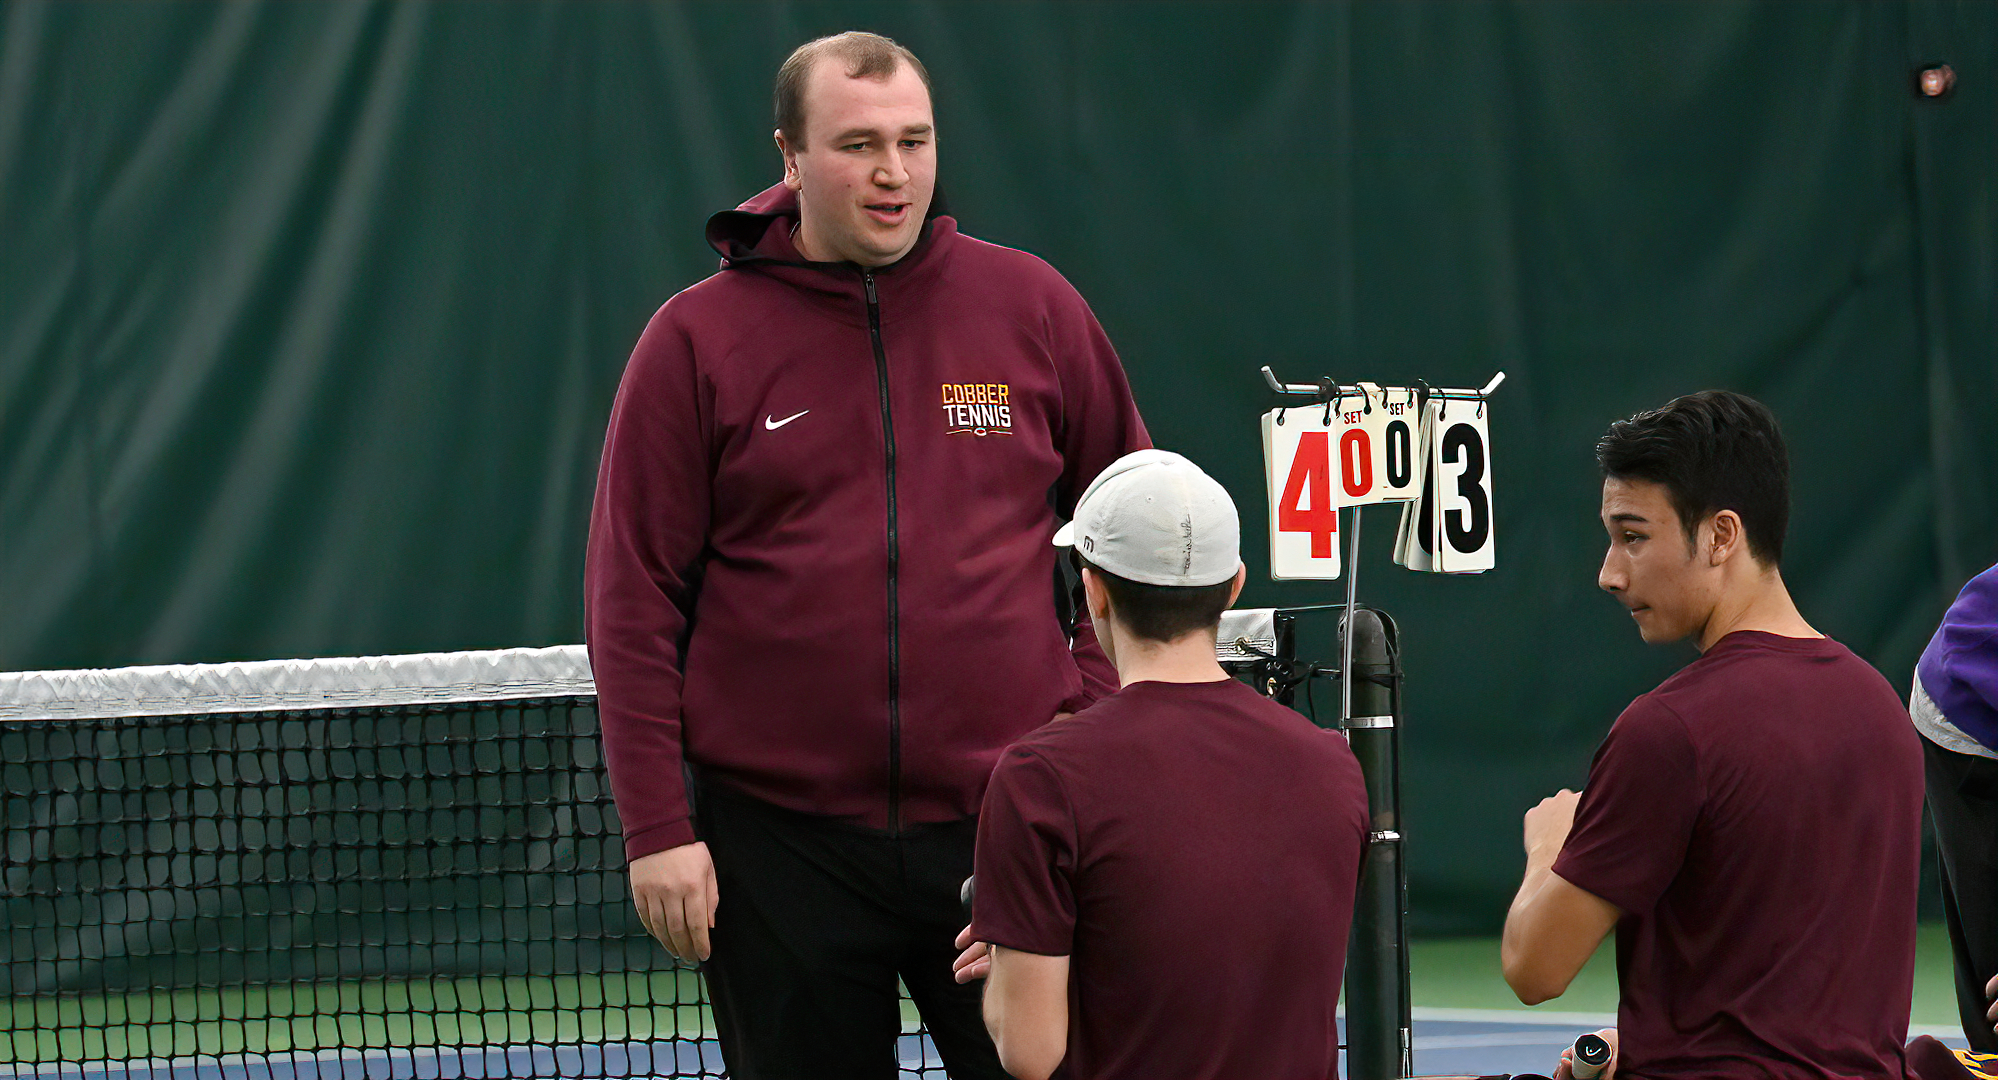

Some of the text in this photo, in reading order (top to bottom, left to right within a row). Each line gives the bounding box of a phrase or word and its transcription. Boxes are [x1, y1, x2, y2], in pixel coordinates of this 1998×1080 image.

[942, 383, 1009, 404] COBBER
[942, 404, 1011, 427] TENNIS
[1389, 402, 1405, 415] SET
[1343, 410, 1363, 425] SET
[1339, 428, 1373, 497] 0
[1385, 419, 1412, 488] 0
[1278, 431, 1337, 559] 4
[1441, 422, 1489, 553] 3
